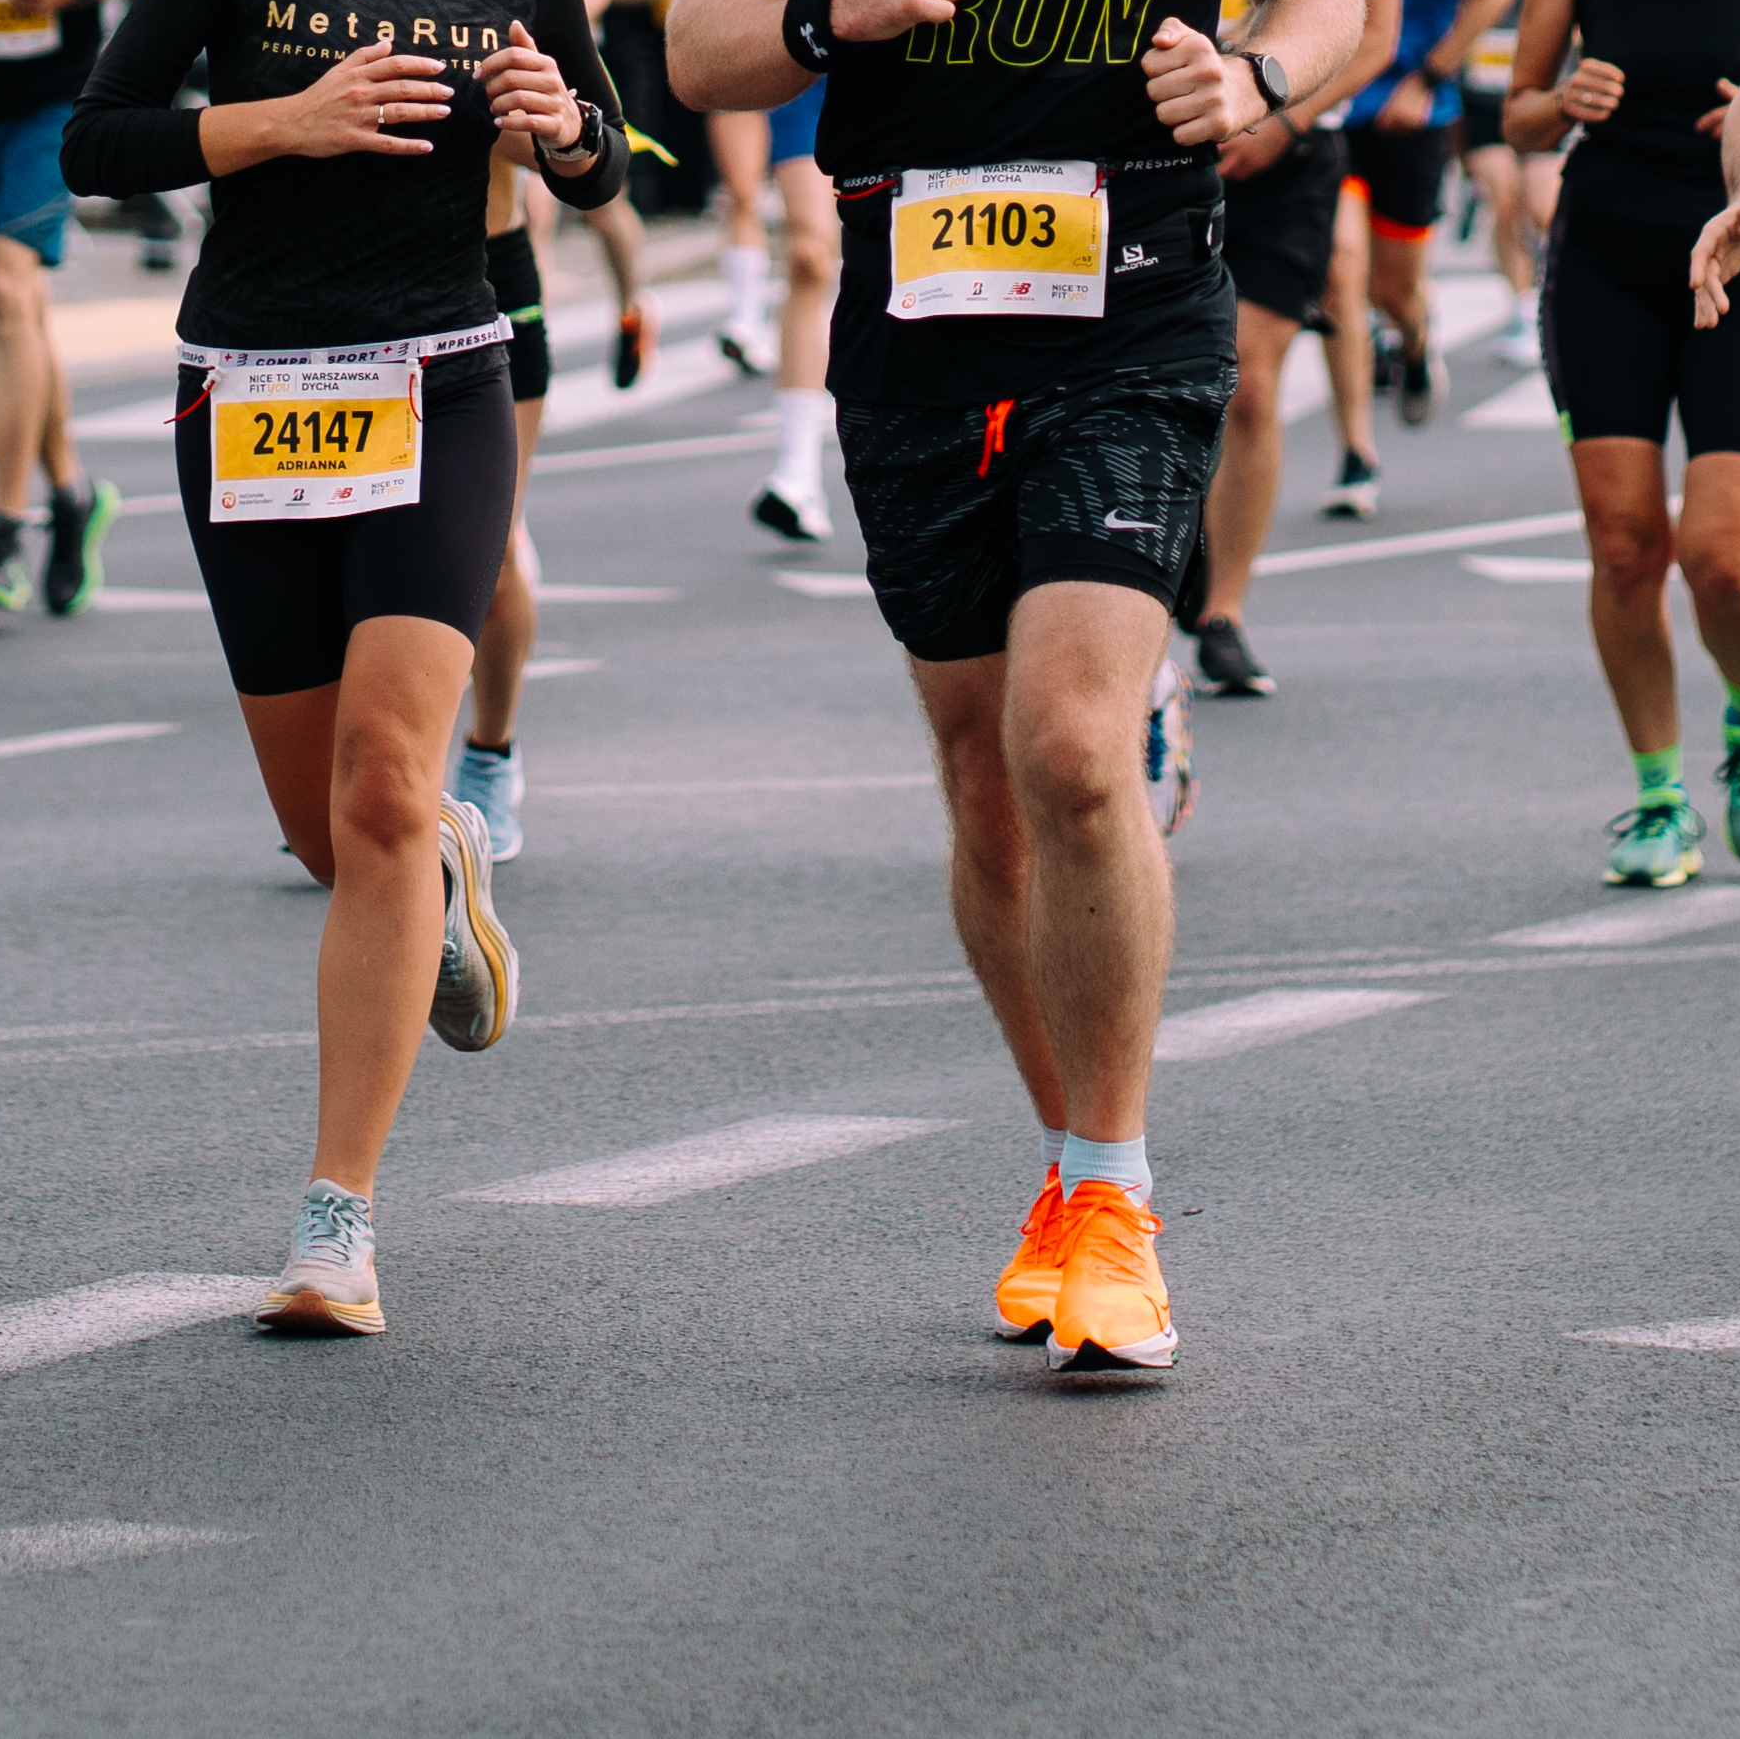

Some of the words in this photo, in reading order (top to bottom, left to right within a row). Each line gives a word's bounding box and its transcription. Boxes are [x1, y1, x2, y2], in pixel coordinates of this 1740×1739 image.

[267, 0, 499, 50] MetaRun
[928, 168, 953, 182] NICE
[956, 167, 970, 176] TO
[982, 164, 1064, 176] WARSZAWSKA
[928, 180, 945, 191] FIT
[946, 176, 970, 191] you
[982, 174, 1022, 184] DYCHA
[932, 202, 1057, 251] 21103
[1114, 257, 1159, 274] salomon
[1051, 284, 1074, 292] NICE
[1076, 285, 1089, 293] TO
[250, 374, 273, 383] NICE
[276, 373, 290, 383] TO
[302, 372, 379, 381] WARSZAWSKA
[250, 384, 267, 393] FIT
[267, 383, 290, 396] you
[302, 382, 339, 391] DYCHA
[253, 411, 374, 455] 24147
[277, 459, 347, 471] ADRIANNA
[371, 480, 391, 489] NICE
[393, 478, 405, 486] TO
[371, 488, 385, 496] FIT
